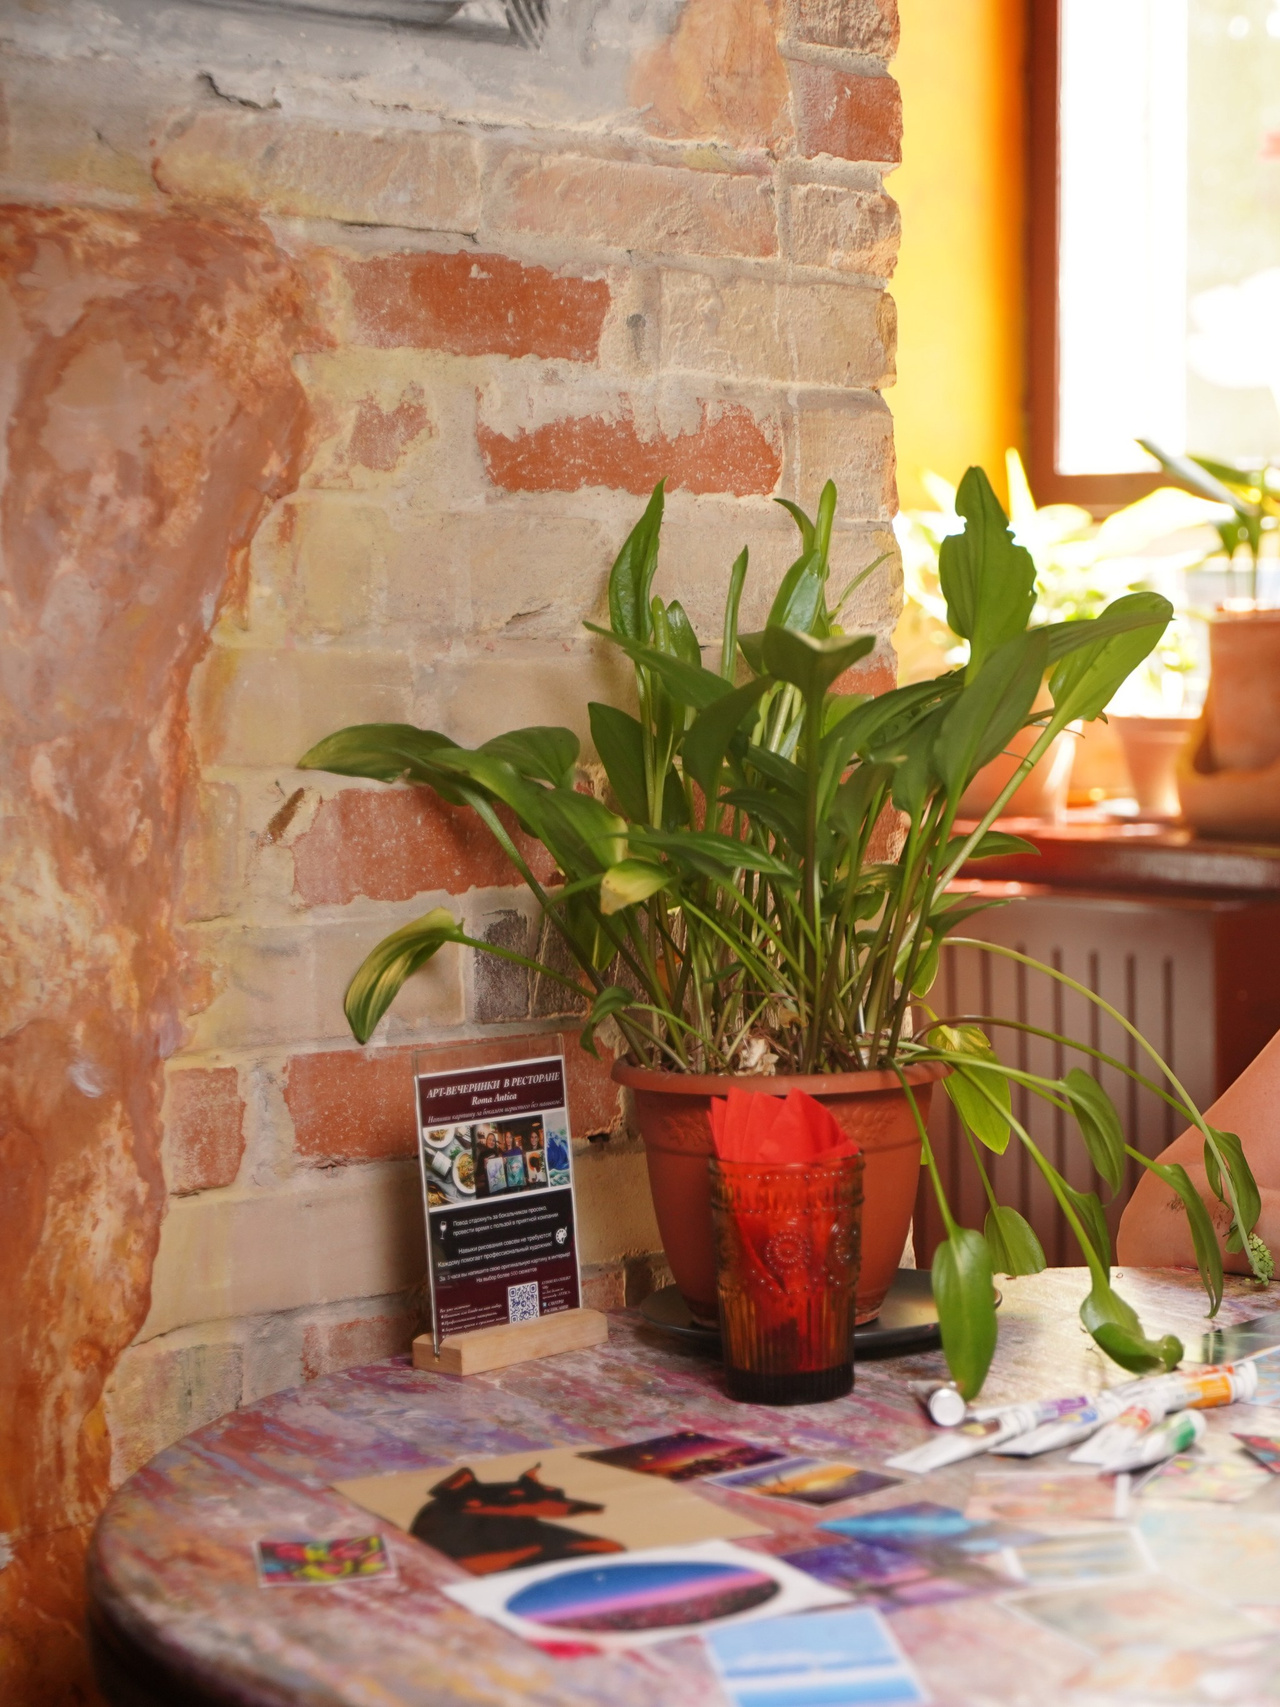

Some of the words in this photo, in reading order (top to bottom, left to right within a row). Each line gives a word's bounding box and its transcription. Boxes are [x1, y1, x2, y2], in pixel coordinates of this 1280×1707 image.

[427, 1080, 500, 1099] АРТ-ВЕЧЕРИНКИ
[503, 1078, 510, 1088] В
[511, 1072, 560, 1087] РЕСТОРАНЕ
[471, 1096, 493, 1106] Roma
[493, 1091, 517, 1103] Antica
